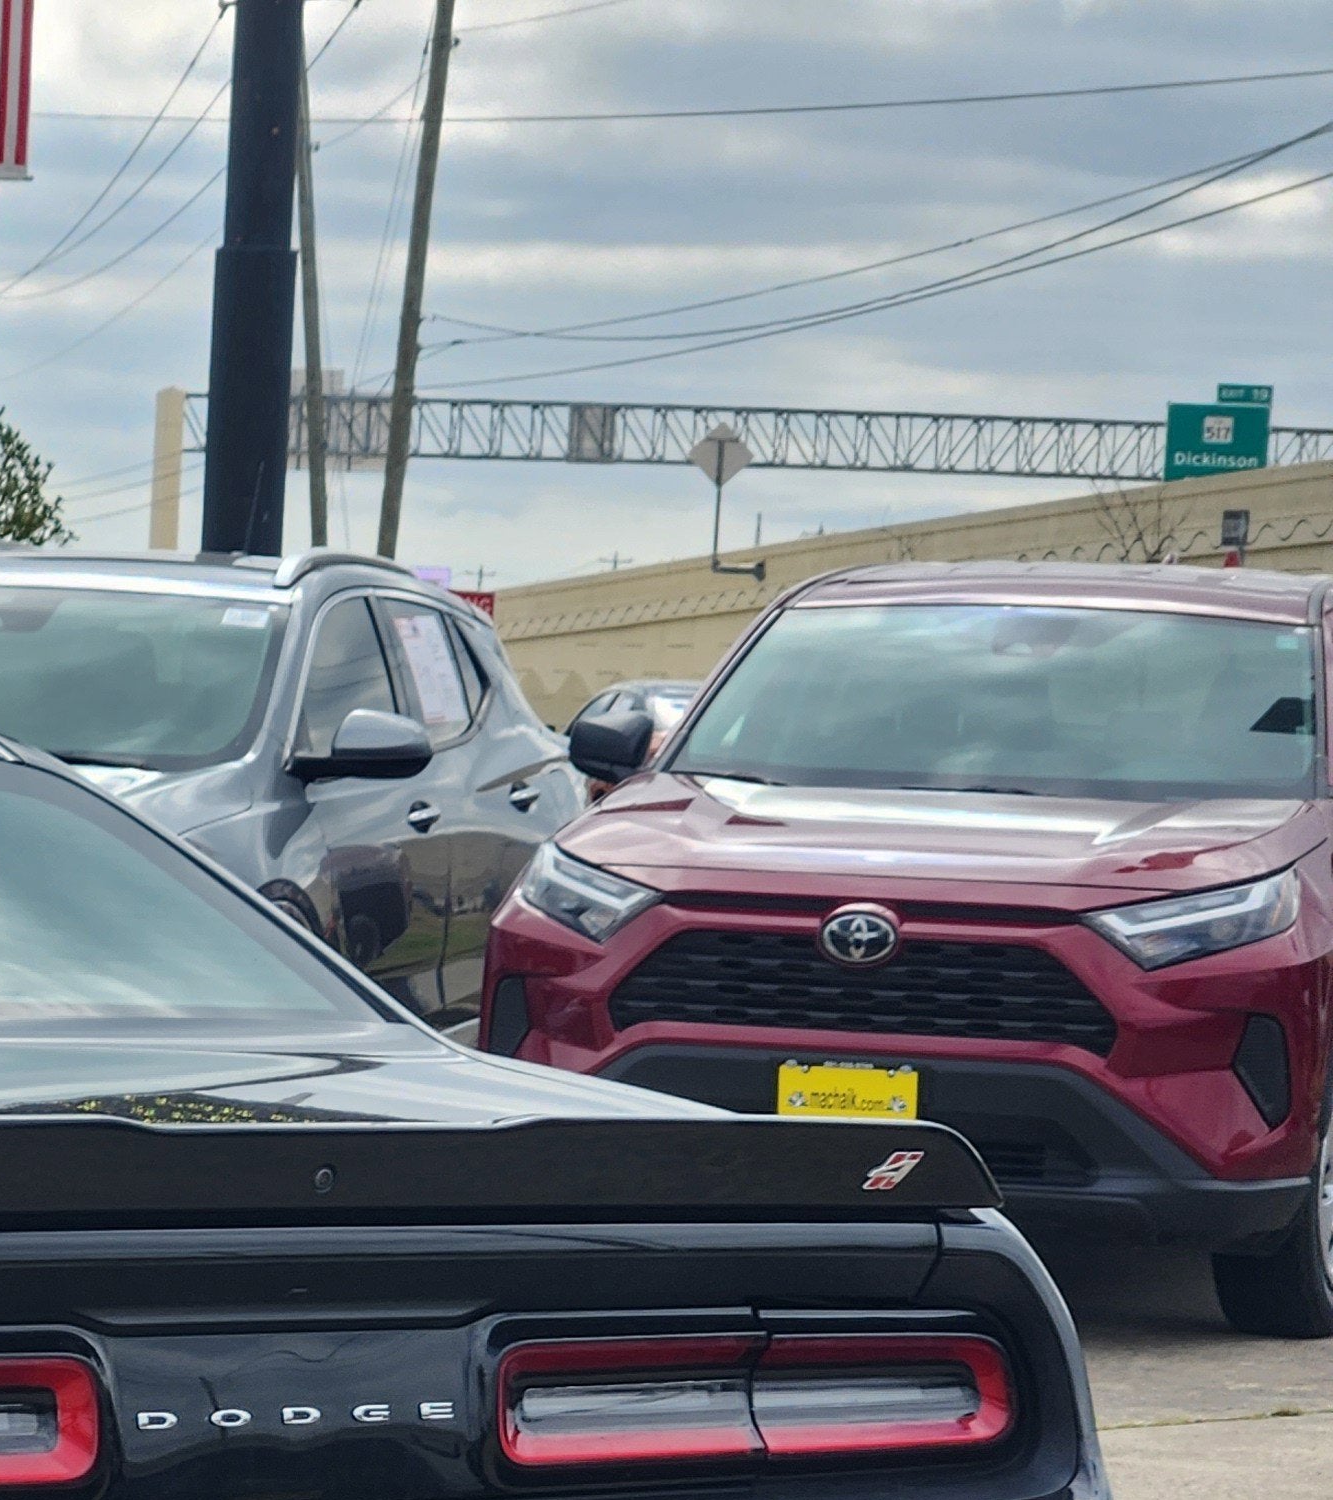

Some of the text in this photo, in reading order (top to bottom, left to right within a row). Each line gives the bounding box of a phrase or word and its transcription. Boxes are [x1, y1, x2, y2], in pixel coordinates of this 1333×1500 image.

[1204, 425, 1231, 441] 517
[1173, 450, 1259, 469] Dickinson
[136, 1401, 456, 1431] DODGE
